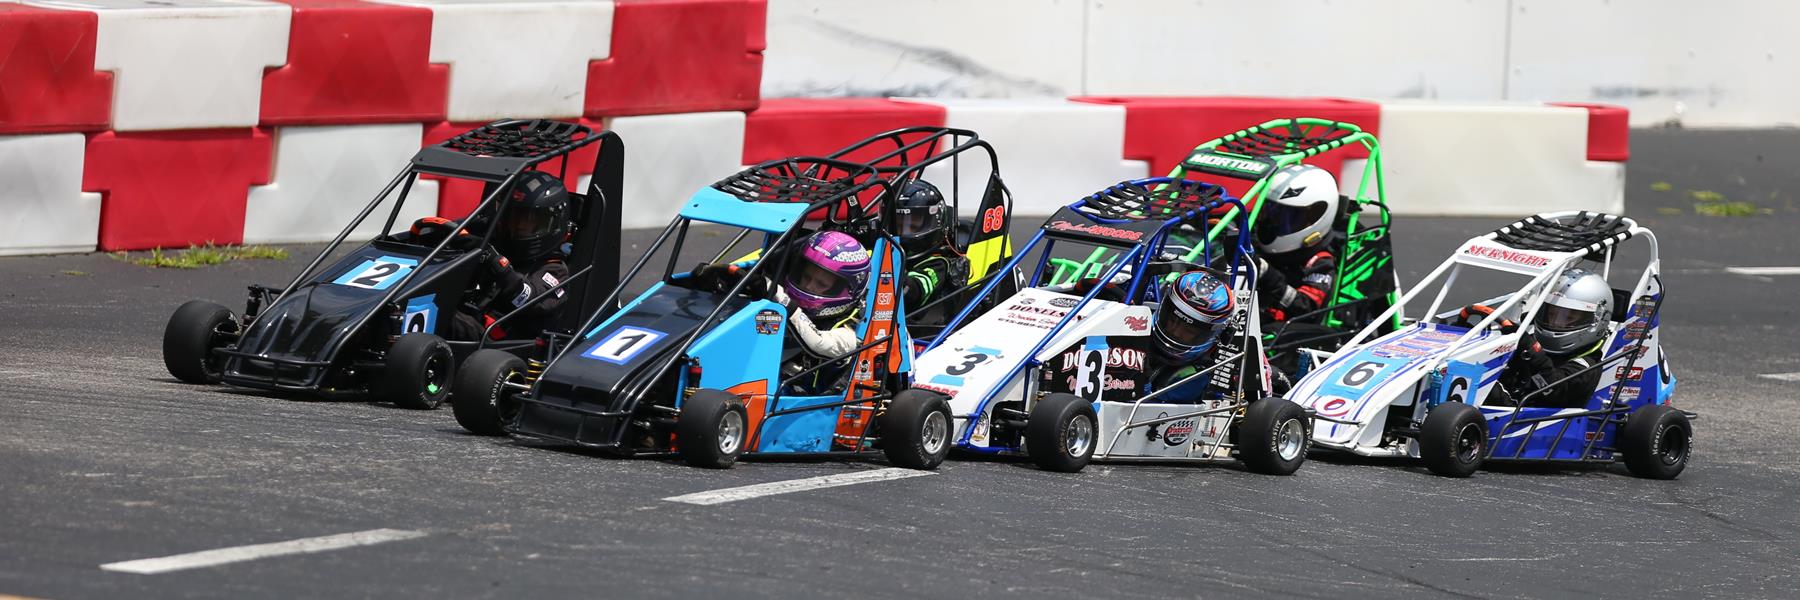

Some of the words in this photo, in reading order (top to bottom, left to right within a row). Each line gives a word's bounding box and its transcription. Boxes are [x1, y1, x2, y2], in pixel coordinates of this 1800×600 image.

[1188, 153, 1267, 172] MORTON
[983, 205, 1004, 233] 68
[351, 263, 401, 286] 2
[613, 333, 648, 357] 1
[946, 353, 988, 376] 3
[1081, 350, 1103, 403] 3
[1343, 361, 1384, 386] 6
